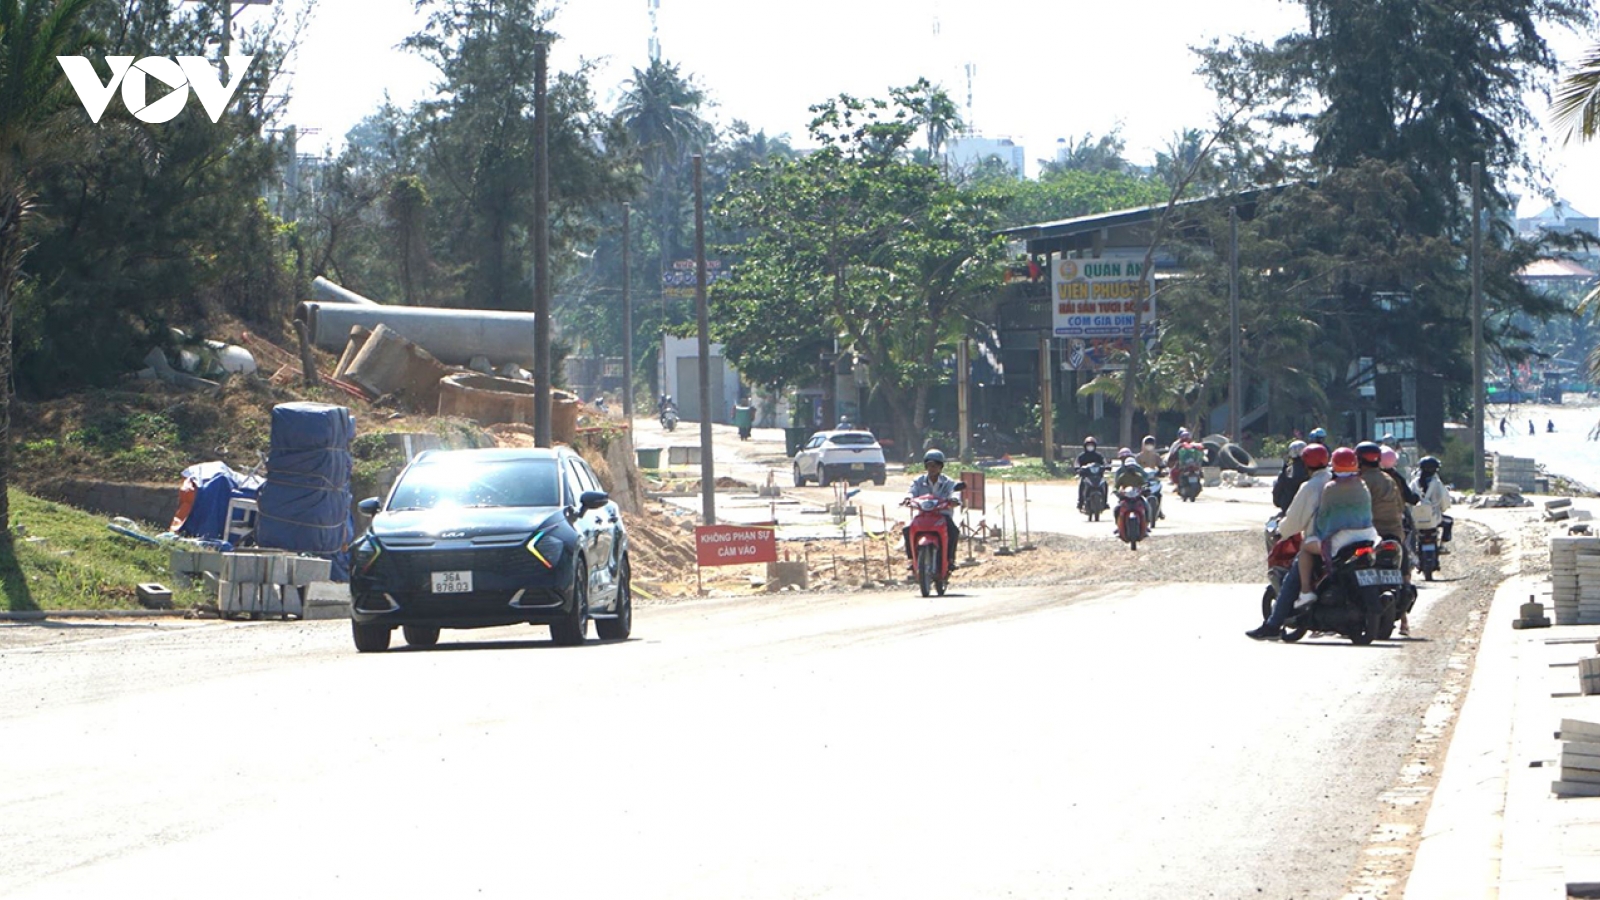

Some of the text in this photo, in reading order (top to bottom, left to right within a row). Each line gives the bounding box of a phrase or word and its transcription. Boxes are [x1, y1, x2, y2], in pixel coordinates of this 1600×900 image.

[701, 531, 732, 543] KHÔNG
[737, 543, 757, 556] VÀO
[442, 572, 461, 582] 36A
